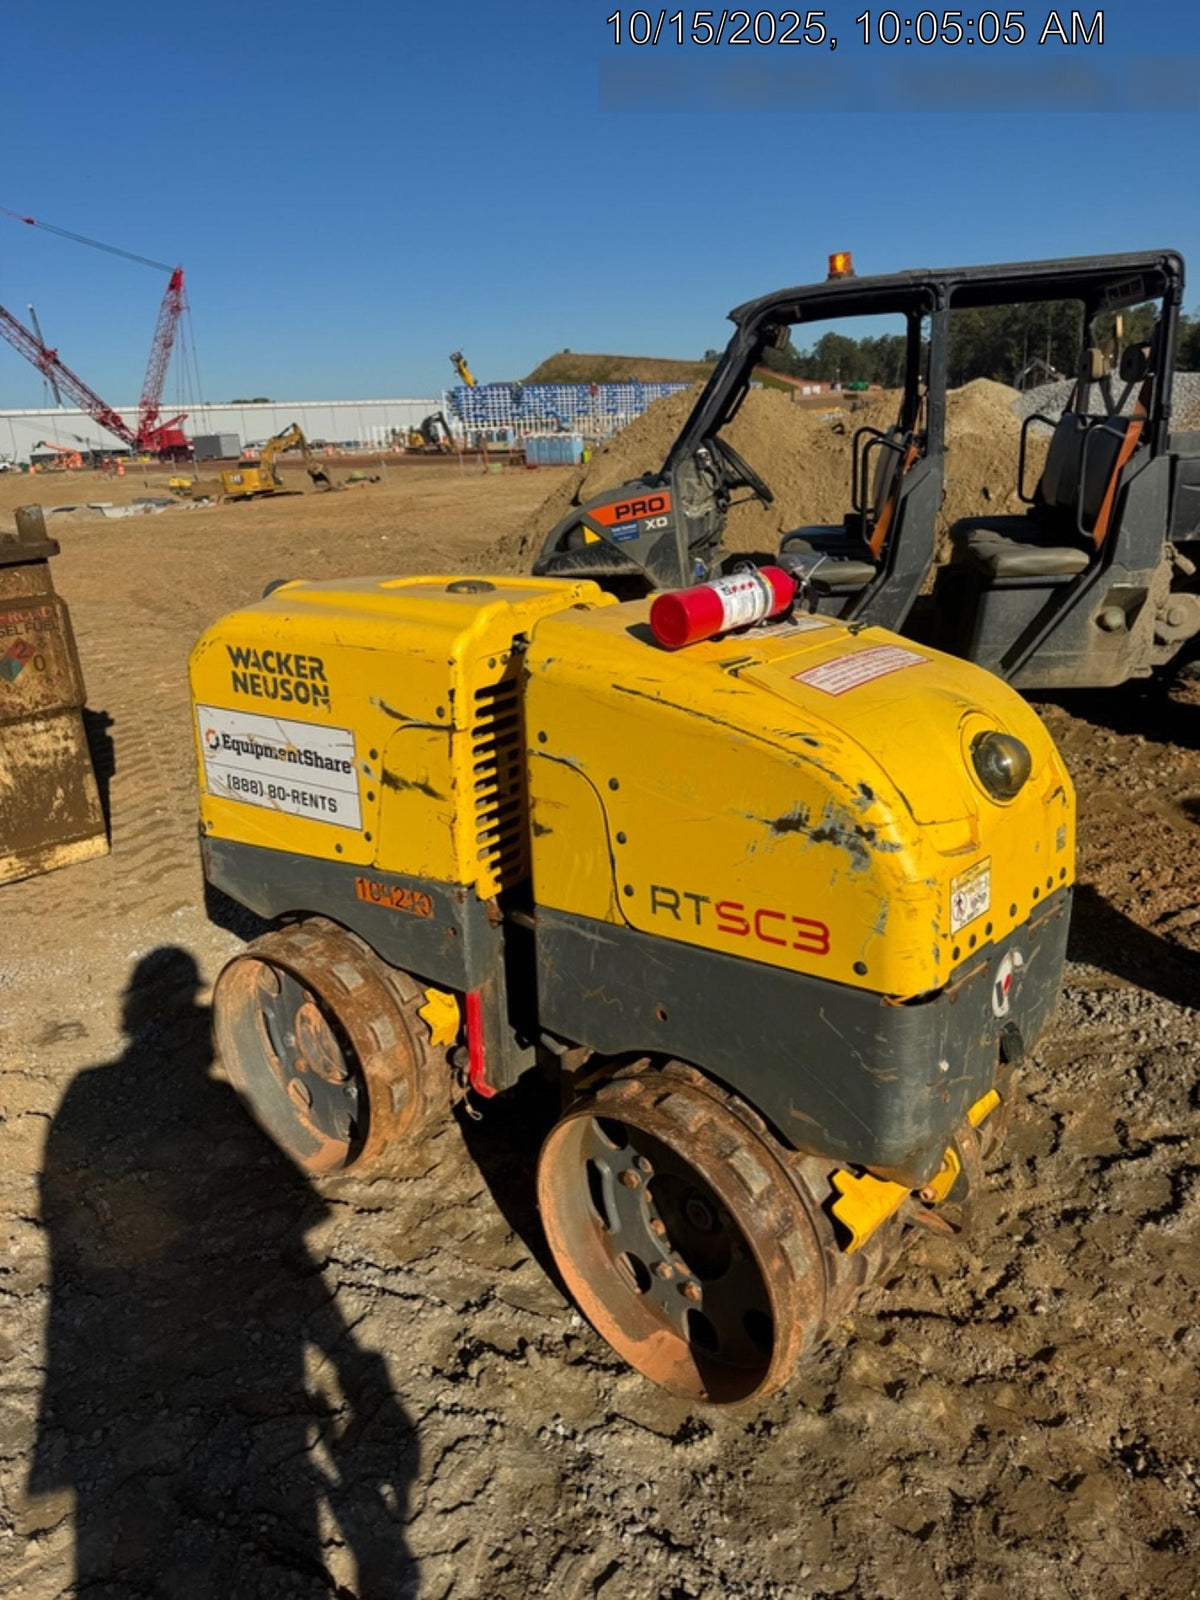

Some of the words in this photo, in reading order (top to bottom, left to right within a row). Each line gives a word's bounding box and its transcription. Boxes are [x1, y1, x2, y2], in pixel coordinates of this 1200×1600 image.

[615, 497, 665, 520] PRO
[644, 516, 668, 530] XD
[33, 654, 47, 672] 0
[226, 644, 328, 682] WACKER
[231, 670, 331, 707] NEUSON
[221, 733, 352, 775] EquipmentShare
[226, 774, 265, 797] (888)
[267, 783, 338, 813] 80-RENTS
